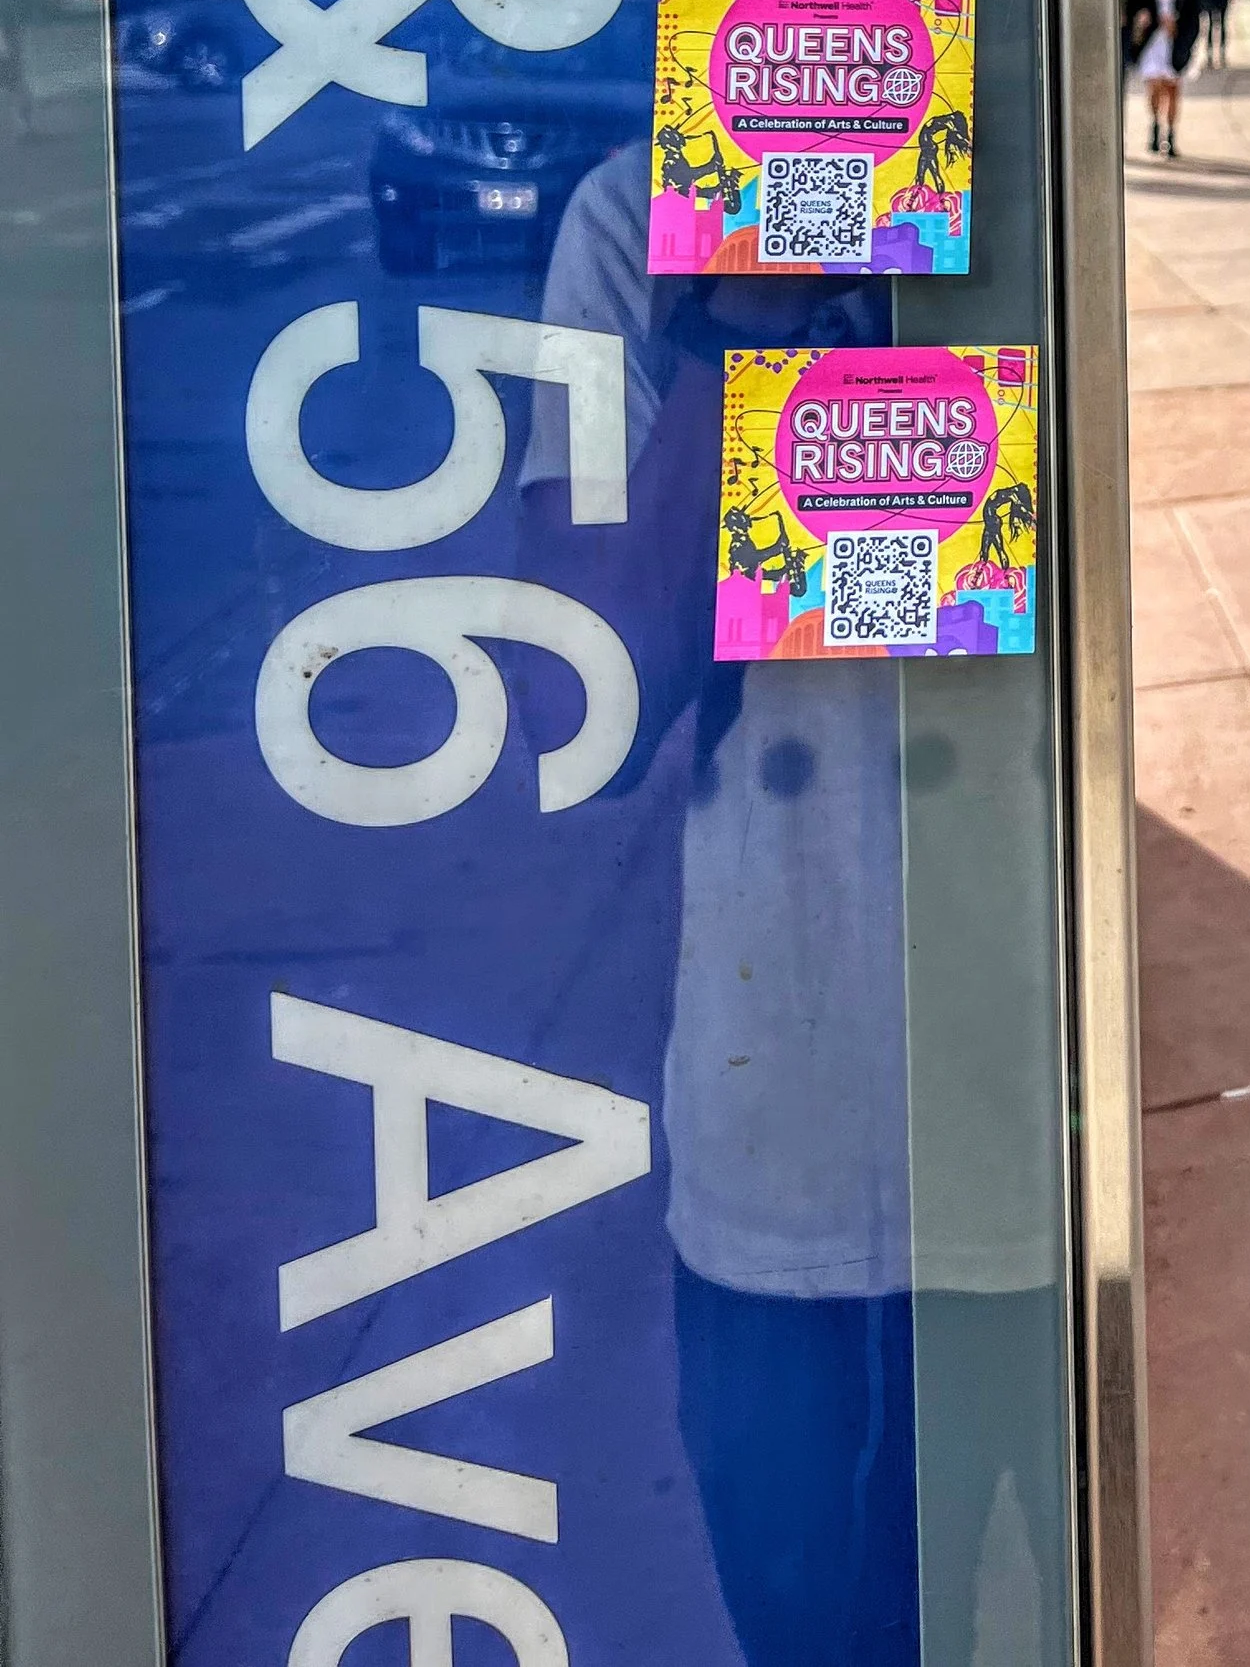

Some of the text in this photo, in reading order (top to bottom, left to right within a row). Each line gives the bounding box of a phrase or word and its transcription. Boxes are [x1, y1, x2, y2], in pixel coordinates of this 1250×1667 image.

[790, 1, 872, 10] Northwell Health
[727, 24, 910, 63] QUEENS
[727, 65, 880, 103] RISING
[738, 119, 903, 130] A Celebration of Arts & Culture
[855, 375, 936, 385] Northwell Health
[792, 399, 975, 440] QUEENS
[793, 441, 944, 481] RISING
[803, 494, 967, 508] A Celebration of Arts & Culture
[245, 301, 640, 827] 56
[865, 579, 896, 587] QUEENS
